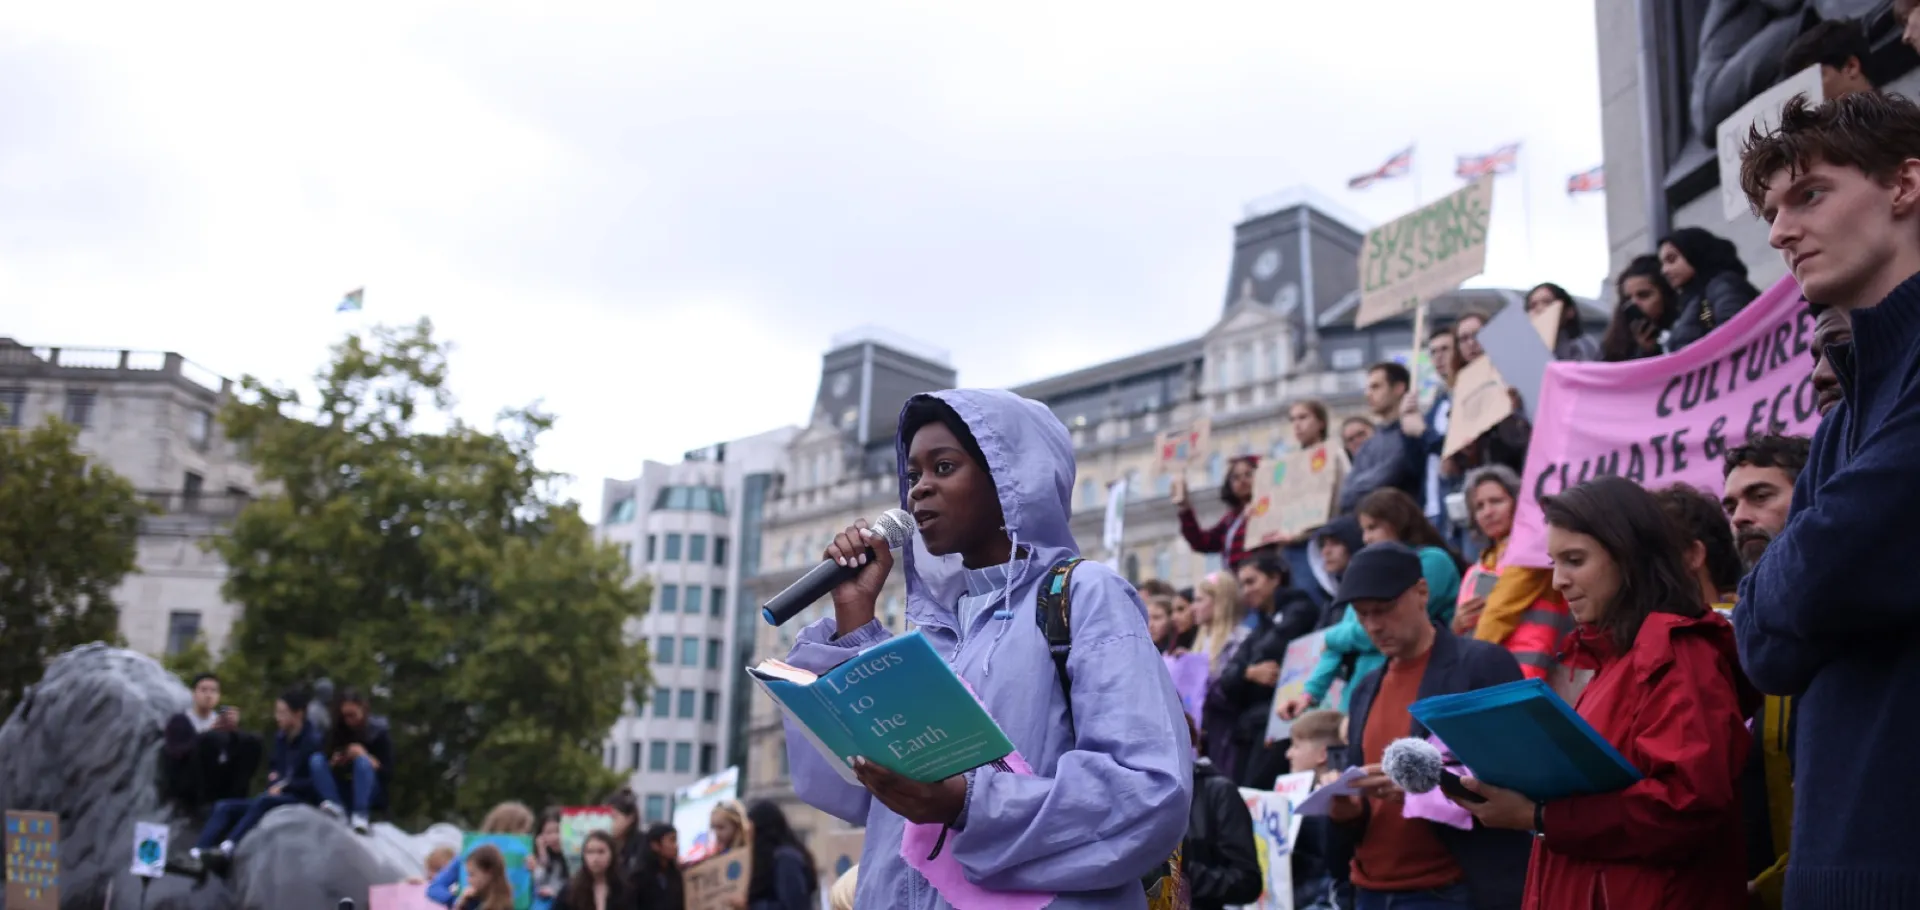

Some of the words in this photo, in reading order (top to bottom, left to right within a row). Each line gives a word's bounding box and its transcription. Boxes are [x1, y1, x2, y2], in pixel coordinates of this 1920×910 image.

[1364, 209, 1488, 292] LESSONS
[1656, 308, 1811, 418] CULTURE
[1703, 415, 1727, 461] &
[827, 651, 903, 695] Letters
[849, 695, 874, 715] to
[870, 713, 907, 738] the
[888, 725, 948, 759] Earth
